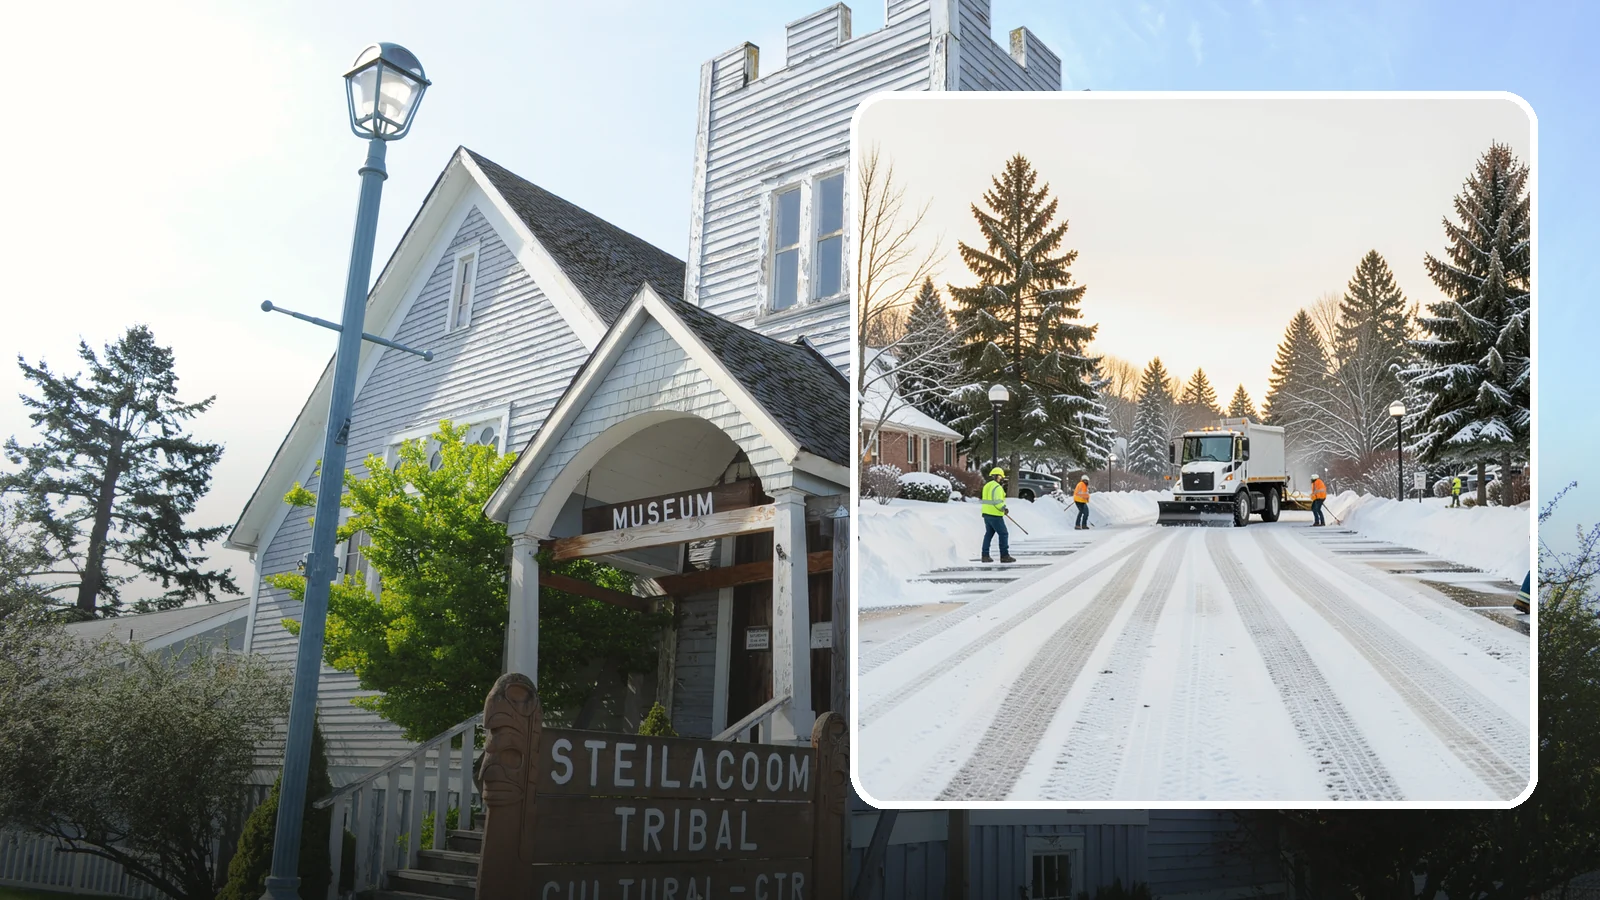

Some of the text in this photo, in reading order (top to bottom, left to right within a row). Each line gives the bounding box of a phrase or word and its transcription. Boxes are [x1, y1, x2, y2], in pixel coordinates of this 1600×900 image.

[613, 491, 714, 531] MUSEUM
[550, 738, 809, 793] STEILACOOM
[615, 807, 758, 852] TRIBAL
